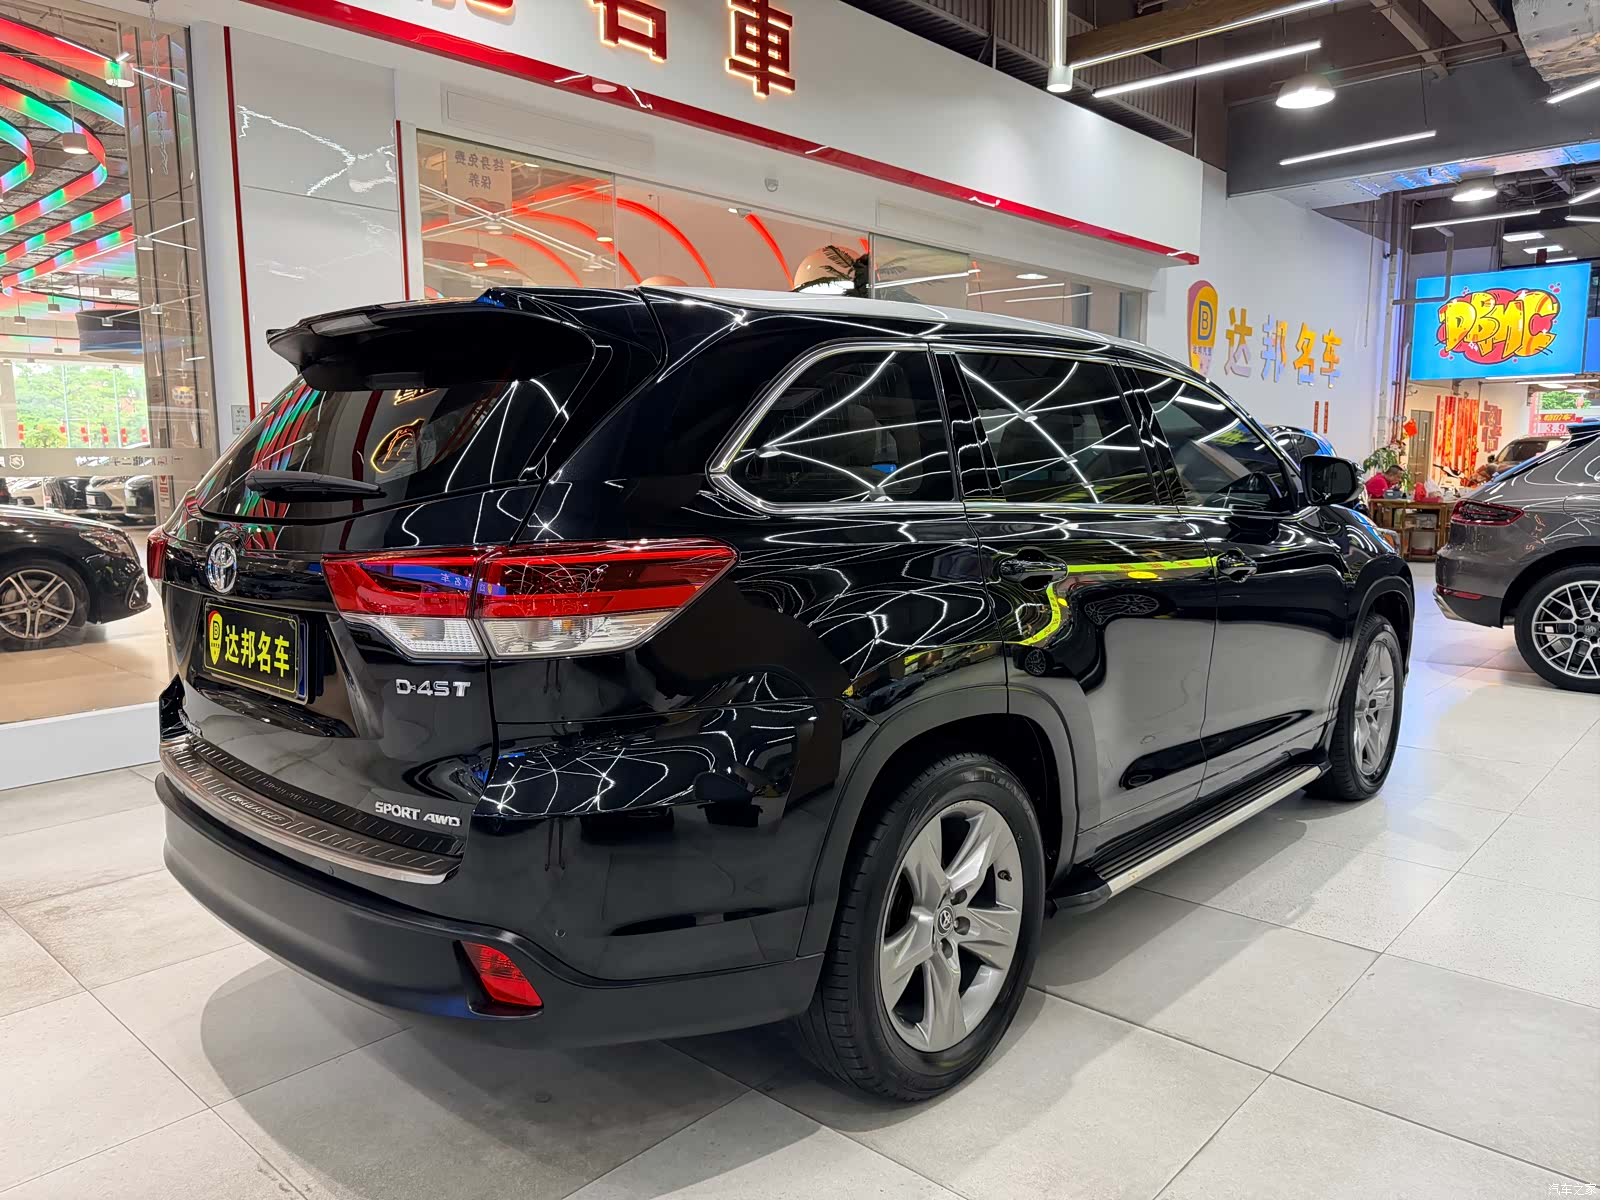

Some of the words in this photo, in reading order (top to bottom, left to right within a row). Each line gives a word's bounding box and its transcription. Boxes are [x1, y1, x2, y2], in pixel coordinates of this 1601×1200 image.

[1224, 307, 1343, 389] 达邦名车
[225, 624, 290, 678] 达邦名车
[375, 801, 421, 821] SPORT
[423, 813, 462, 827] AWD
